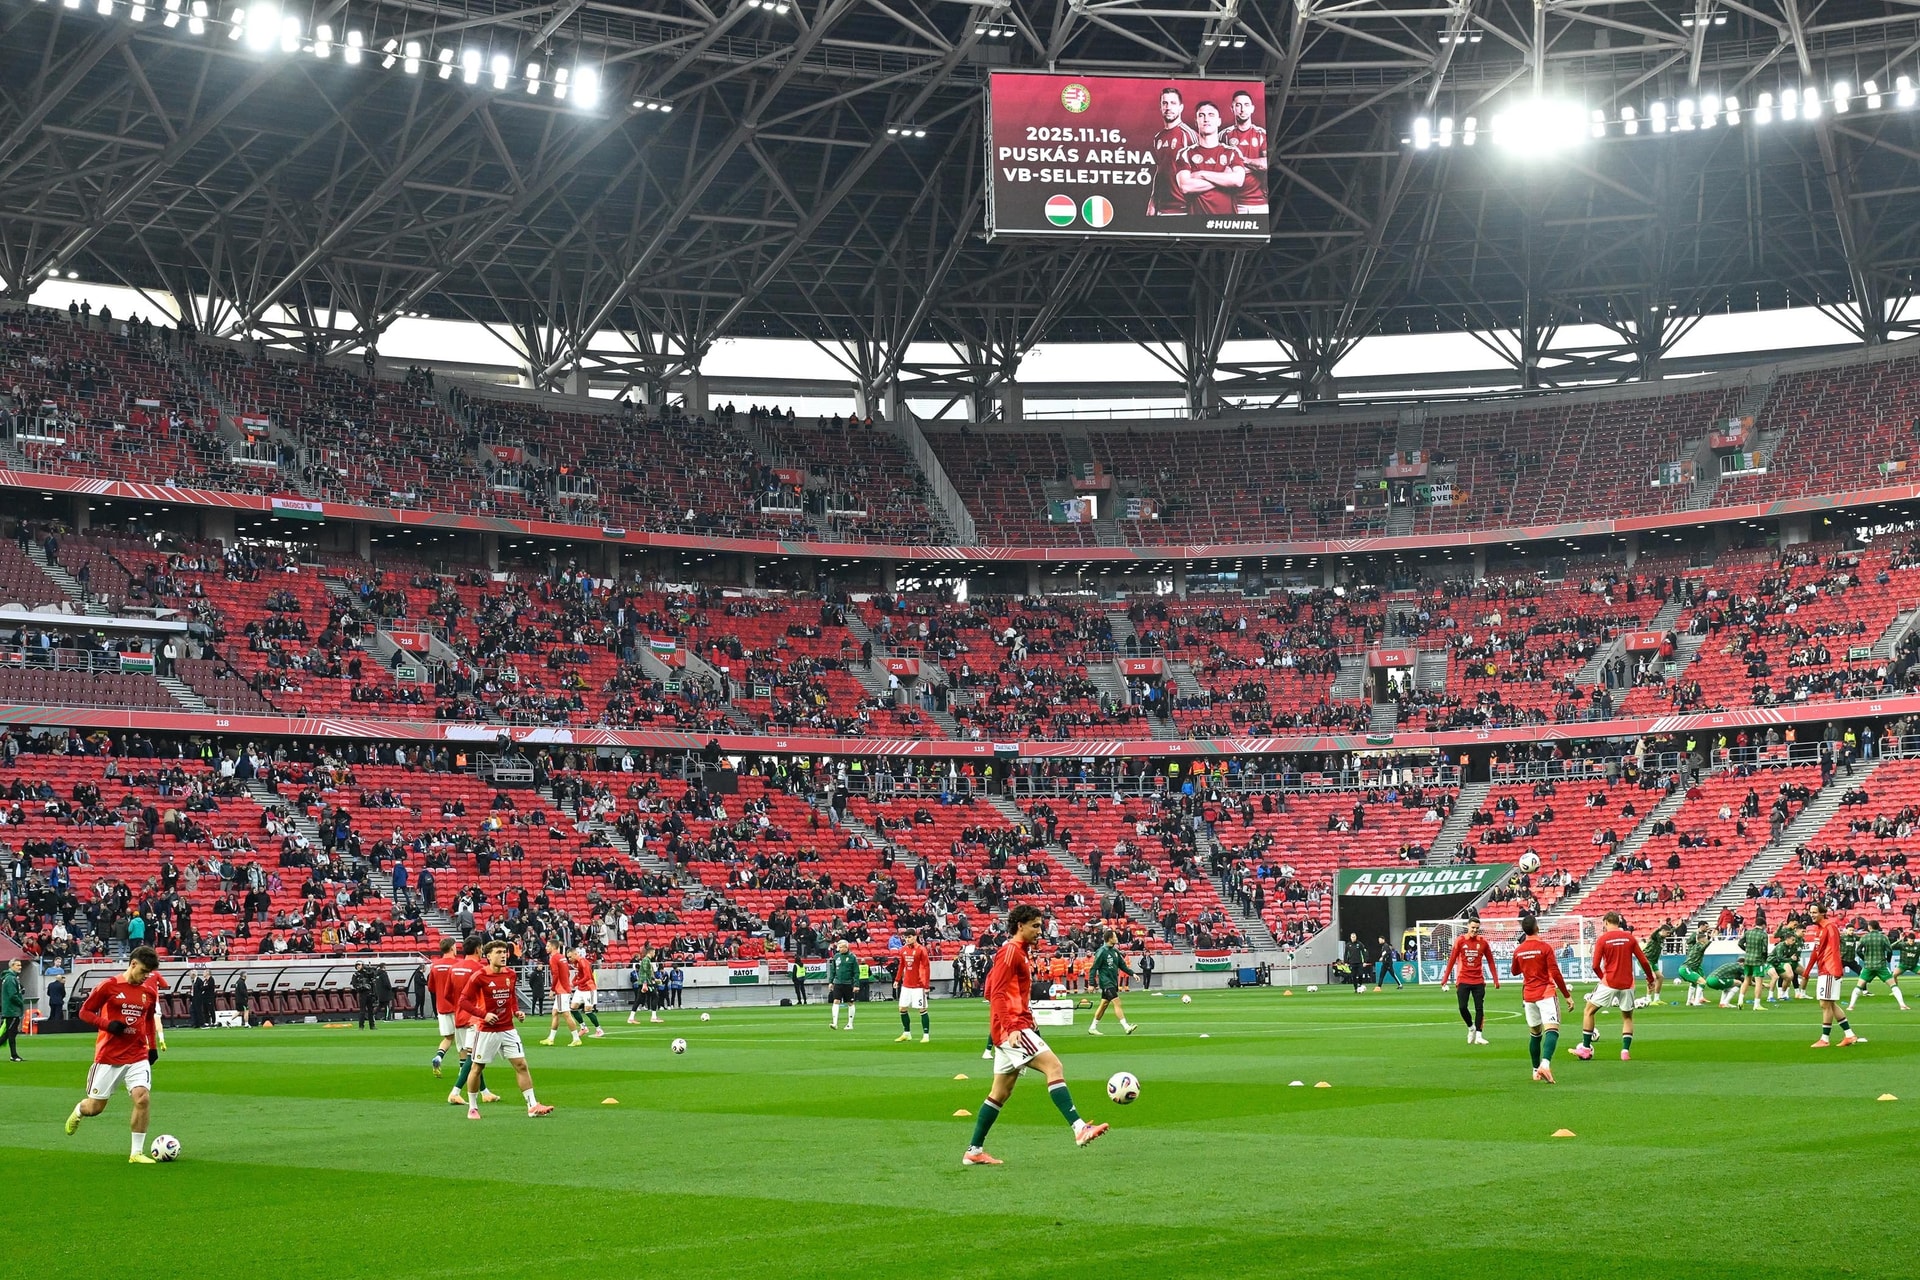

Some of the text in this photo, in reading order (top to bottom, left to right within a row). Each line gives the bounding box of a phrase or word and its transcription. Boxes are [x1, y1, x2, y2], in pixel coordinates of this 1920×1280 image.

[1025, 126, 1127, 143] 2025.11.16.
[999, 145, 1156, 165] PUSKÁS ARÉNA
[1003, 167, 1152, 186] VB-SELEJTEZŐ
[1206, 219, 1260, 230] #HUNIRL
[1354, 869, 1490, 884] A GYŰLÖLET
[1345, 881, 1482, 897] NEM PÁLYA!
